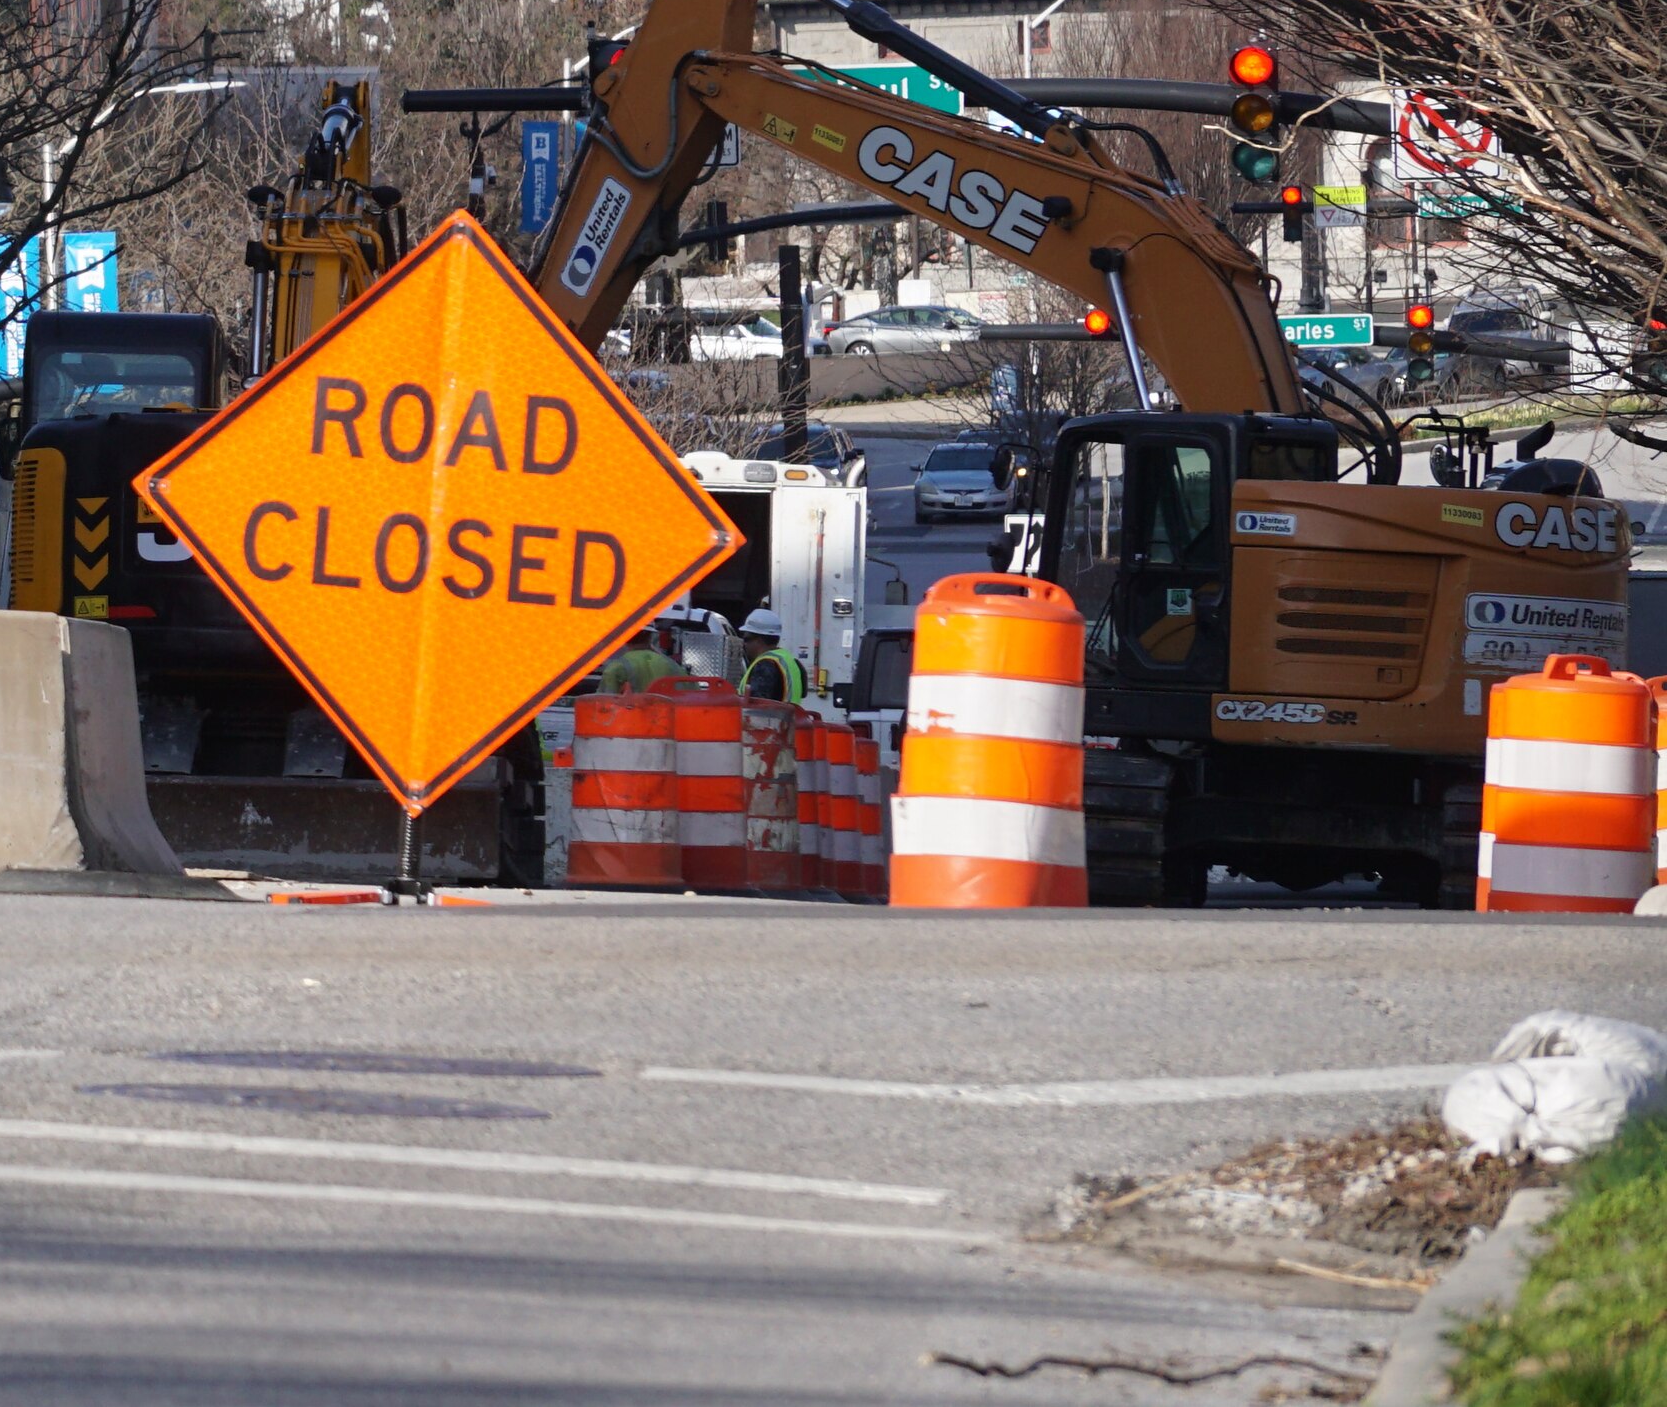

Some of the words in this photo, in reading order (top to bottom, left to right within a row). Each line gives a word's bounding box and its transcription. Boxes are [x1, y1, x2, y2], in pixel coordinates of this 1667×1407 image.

[585, 187, 614, 242] United
[858, 126, 1049, 256] CASE
[595, 192, 626, 251] Rentals
[1285, 322, 1335, 340] arles
[1353, 318, 1367, 329] ST
[311, 376, 578, 475] ROAD
[1259, 524, 1291, 533] Rentals
[1260, 516, 1289, 525] United
[1495, 501, 1617, 553] CASE
[243, 500, 627, 610] CLOSED
[1511, 604, 1579, 628] United
[1581, 606, 1625, 633] Rentals
